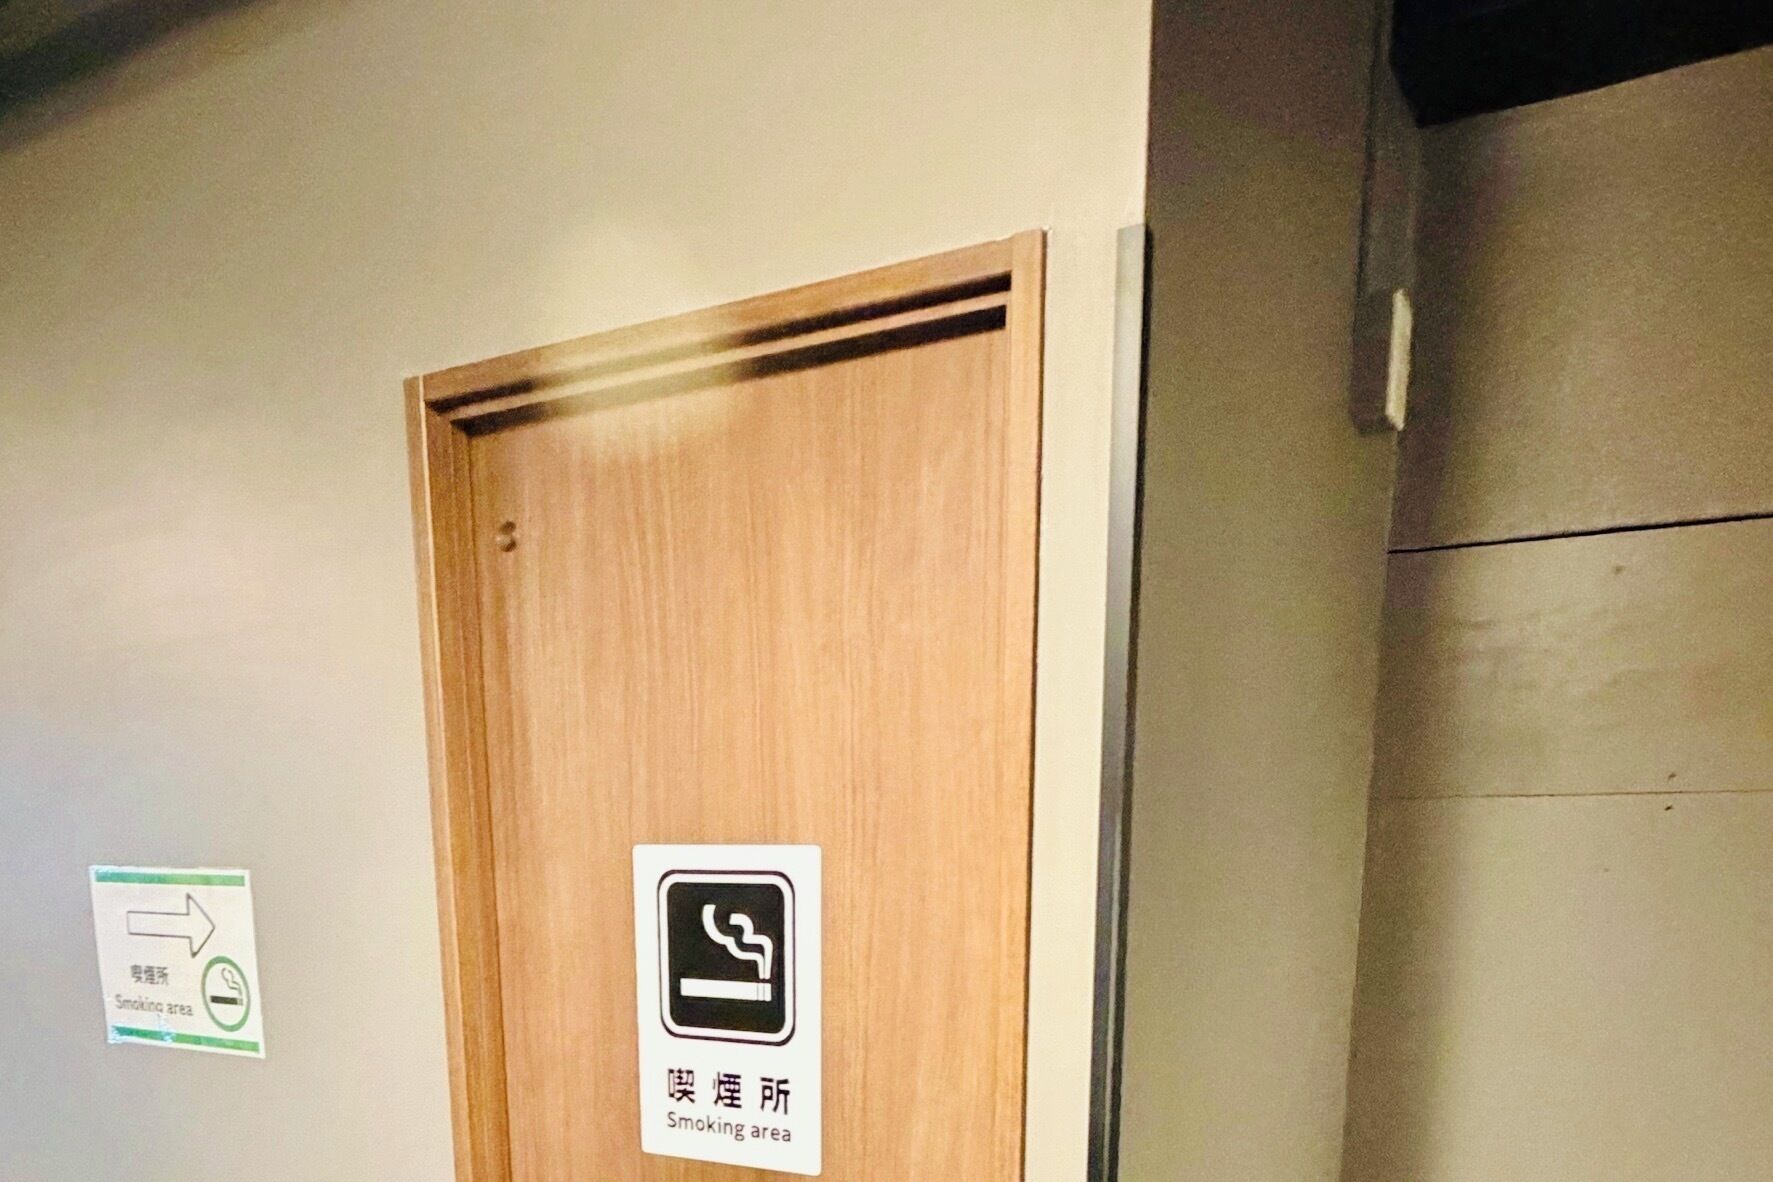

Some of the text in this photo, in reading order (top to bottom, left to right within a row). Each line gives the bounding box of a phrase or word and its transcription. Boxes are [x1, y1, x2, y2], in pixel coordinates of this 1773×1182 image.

[115, 994, 194, 1016] Smoking area
[667, 1067, 790, 1116] 喫煙所
[667, 1111, 792, 1142] Smoking area
